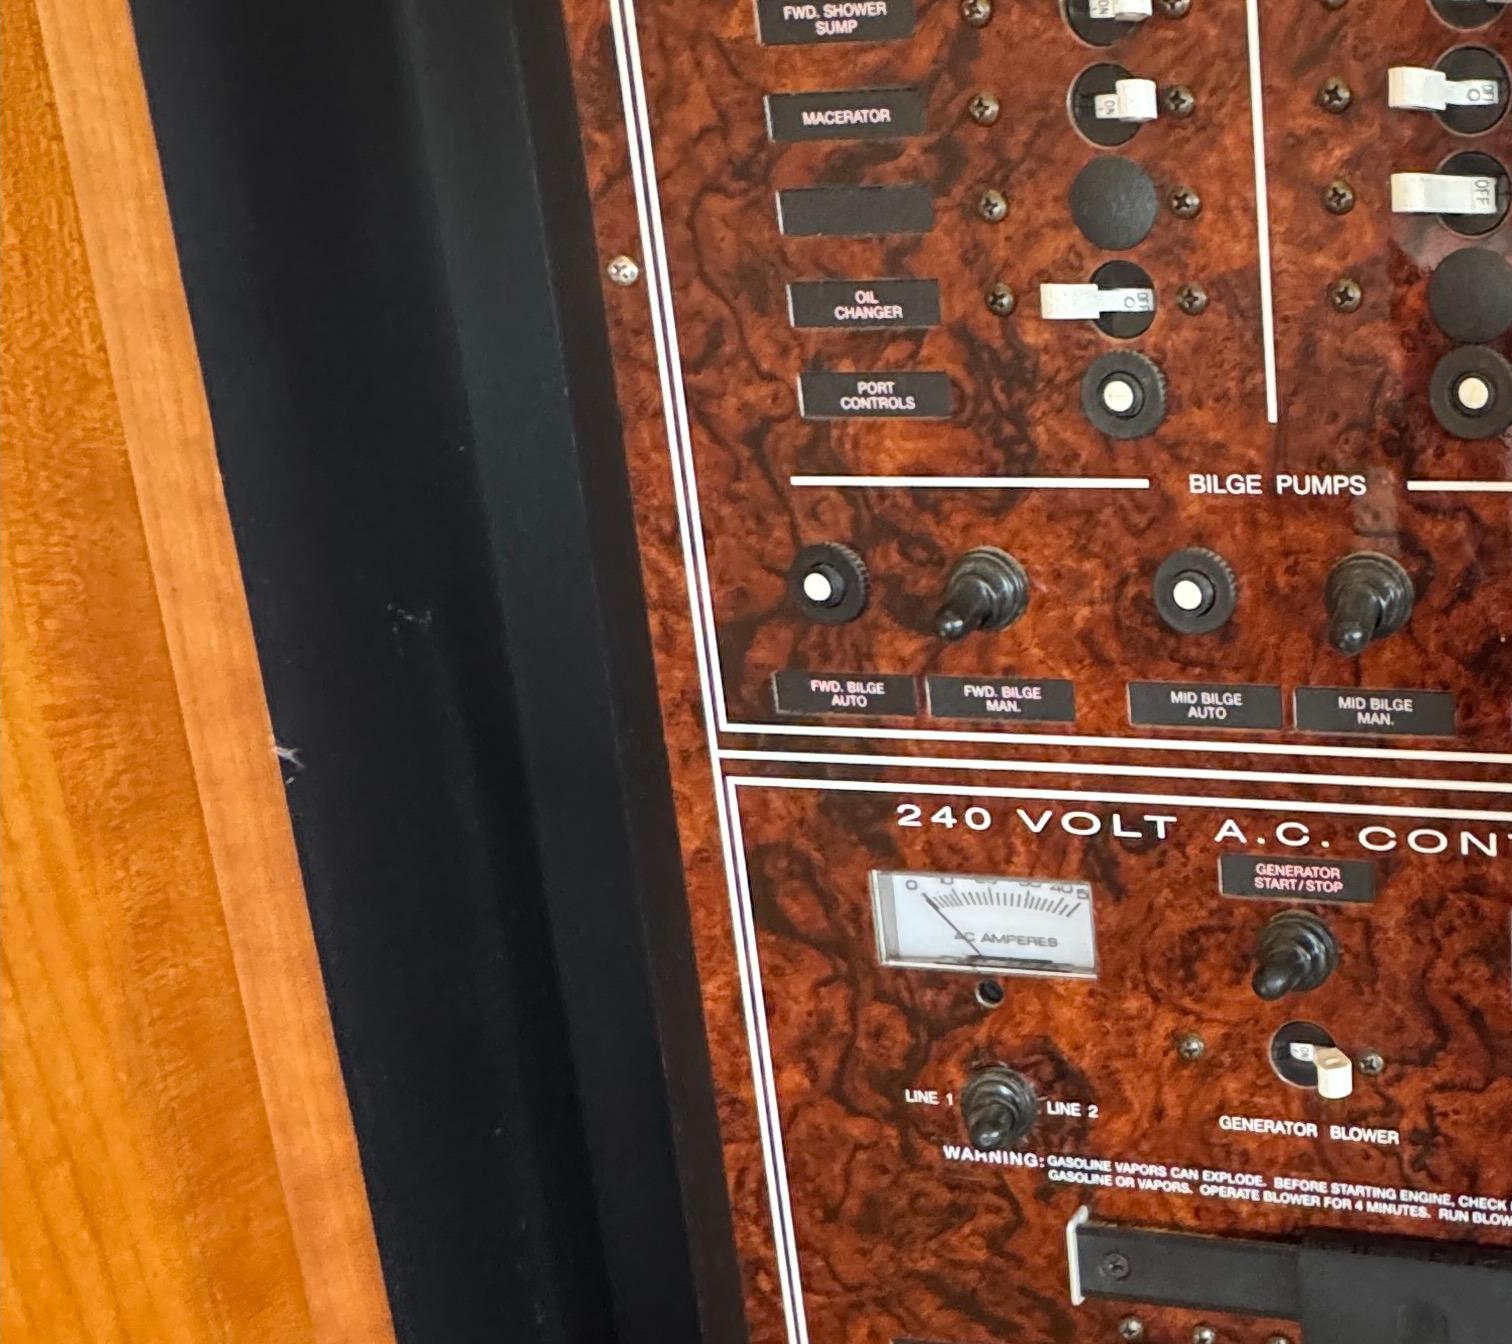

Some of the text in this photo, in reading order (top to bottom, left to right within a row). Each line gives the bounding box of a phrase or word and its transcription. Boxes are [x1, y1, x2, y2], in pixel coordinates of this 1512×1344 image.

[783, 1, 887, 20] FWD. SHOWER
[815, 20, 858, 36] SUMP
[802, 109, 891, 126] MACERATOR
[854, 290, 878, 304] OIL
[834, 305, 903, 320] CHANGER
[857, 381, 895, 394] PORT
[840, 396, 915, 410] CONTROLS
[1189, 474, 1366, 496] BILGE PUMPS
[810, 680, 885, 695] FWD. BILGE
[963, 684, 1042, 700] FWD. BILGE
[831, 693, 867, 708] AUTO
[985, 699, 1022, 713] MAN.
[1170, 690, 1243, 706] MID BILGE
[1338, 696, 1413, 712] MID BILGE
[1188, 704, 1227, 719] AUTO
[1357, 710, 1394, 725] MAN.
[897, 803, 992, 830] 240
[1016, 808, 1177, 839] VOLT
[1214, 819, 1330, 848] A.C.
[1256, 863, 1341, 880] GENERATOR
[1254, 877, 1343, 894] START/STOP
[981, 932, 1058, 948] AMPERES
[905, 1089, 953, 1106] LINE 1
[1046, 1101, 1099, 1119] LINE 2
[1218, 1115, 1399, 1145] GENERATOR BLOWER
[943, 1145, 1045, 1168] WARNING:
[1047, 1154, 1111, 1172] GASOLINE
[1114, 1161, 1167, 1177] VAPORS
[1170, 1166, 1199, 1179] CAN
[1202, 1169, 1267, 1187] EXPLODE.
[1273, 1176, 1327, 1193] BEFORE
[1330, 1182, 1397, 1200] STARTING
[1400, 1189, 1454, 1207] ENGINE,
[1458, 1194, 1506, 1212] CHECK
[1048, 1168, 1113, 1185] GASOLINE
[1115, 1175, 1135, 1188] OR
[1138, 1179, 1193, 1194] VAPORS.
[1200, 1184, 1260, 1201] OPERATE
[1263, 1190, 1321, 1207] BLOWER
[1324, 1195, 1352, 1210] FOR
[1355, 1199, 1363, 1211] 4
[1366, 1201, 1431, 1219] MINUTES.
[1439, 1208, 1469, 1223] RUN
